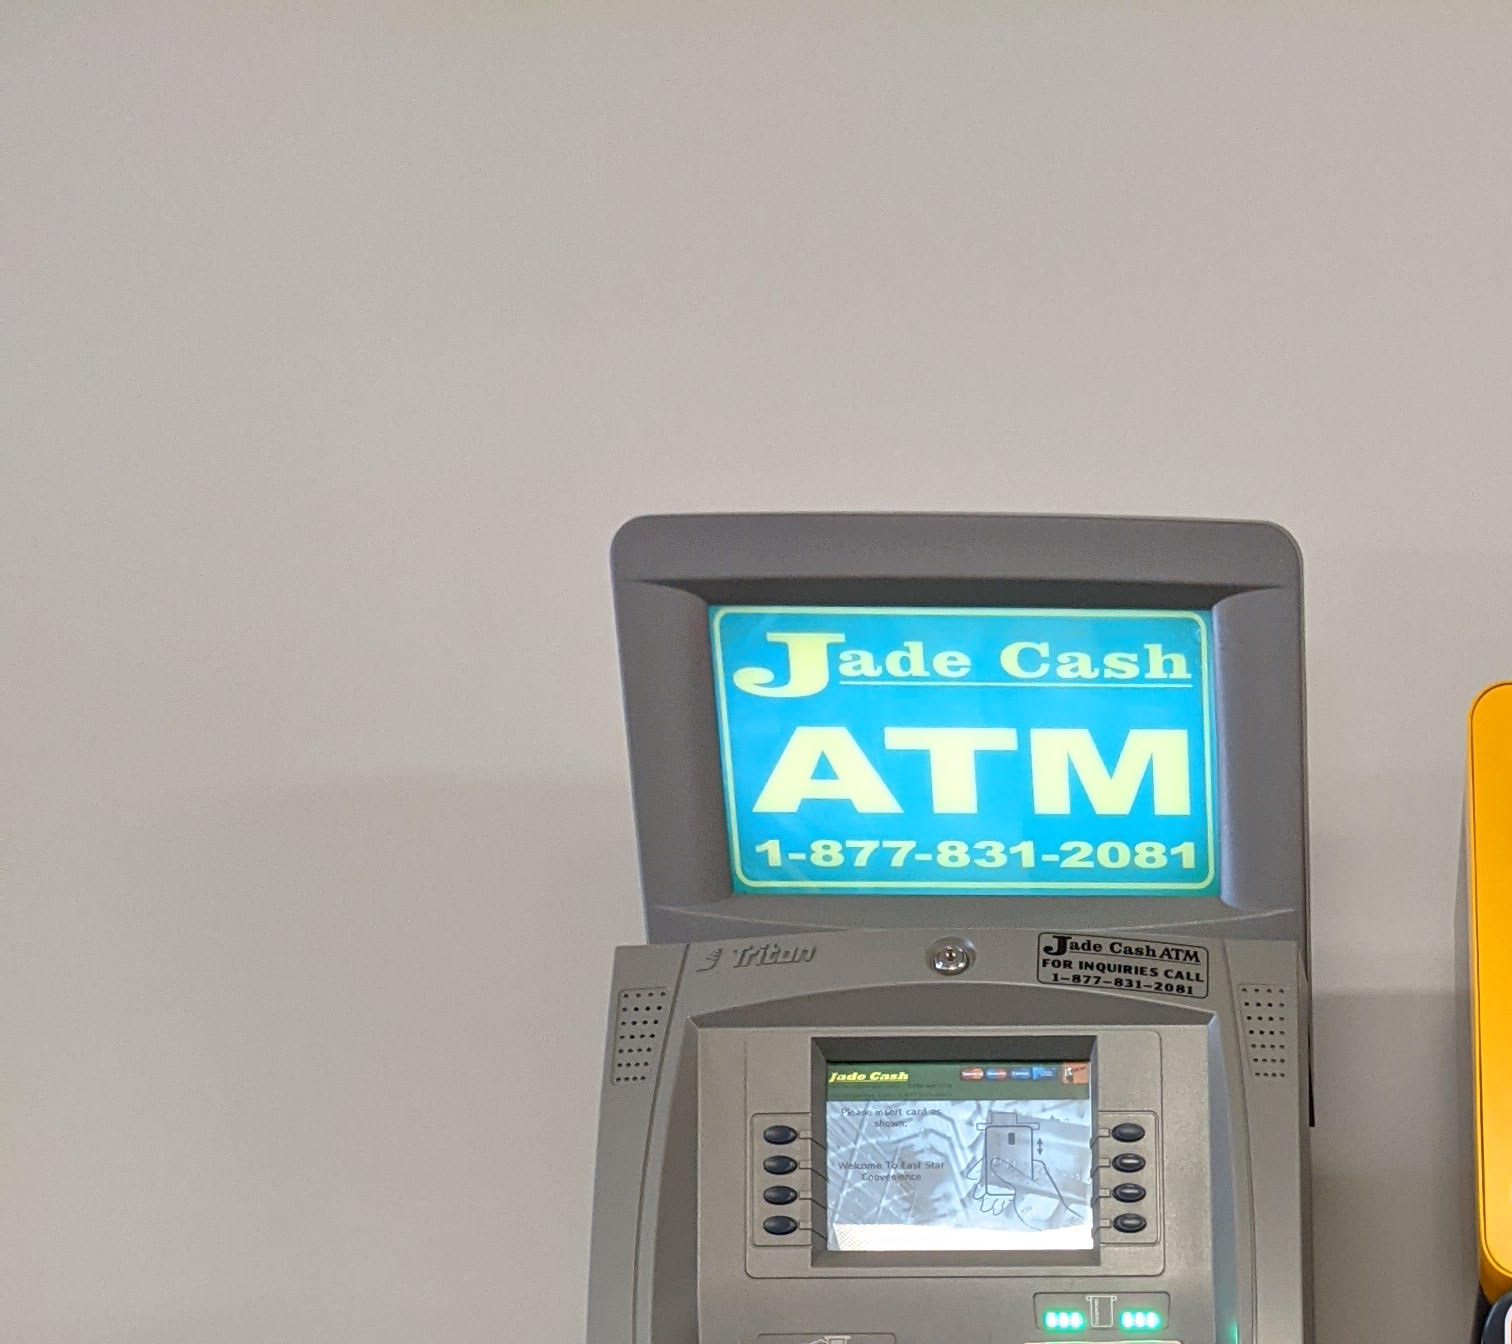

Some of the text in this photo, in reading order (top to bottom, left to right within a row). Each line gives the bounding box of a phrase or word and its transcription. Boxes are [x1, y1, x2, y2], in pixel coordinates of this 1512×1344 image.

[733, 631, 1192, 697] Jade Cash
[752, 725, 1191, 816] ATM
[754, 837, 1196, 870] 1-877-831-2081
[1043, 935, 1200, 963] Jade Cash ATM
[1042, 958, 1204, 982] FOR INQUIRIES CALL
[1052, 972, 1193, 995] 1-877-831-2081
[829, 1071, 908, 1083] Jade Cash
[874, 1119, 908, 1128] shown.
[876, 1108, 902, 1116] insert
[906, 1108, 926, 1116] card
[839, 1161, 881, 1170] Welcome
[886, 1161, 898, 1170] To
[925, 1161, 945, 1169] Star
[862, 1173, 922, 1181] Convenience
